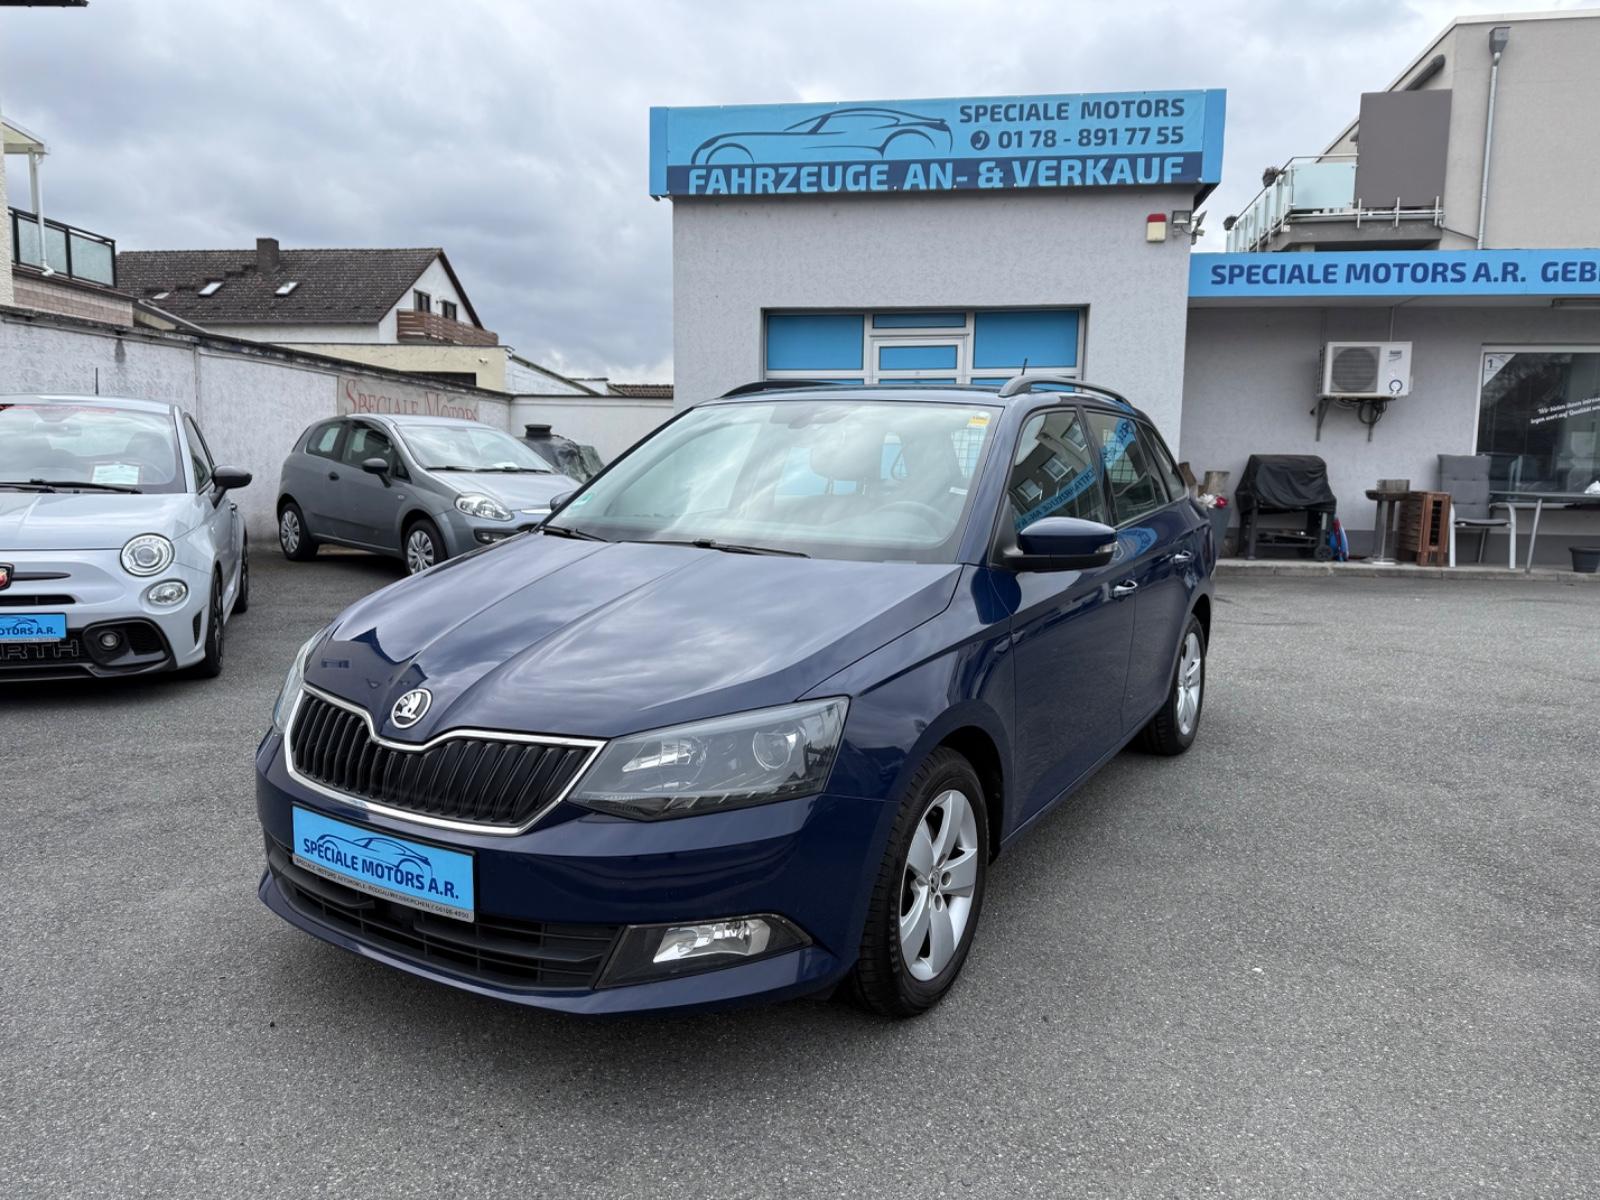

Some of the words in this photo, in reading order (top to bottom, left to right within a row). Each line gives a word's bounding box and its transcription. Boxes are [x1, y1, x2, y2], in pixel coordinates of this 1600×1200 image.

[960, 102, 1069, 123] SPECIALE
[1081, 98, 1185, 120] MOTORS
[689, 164, 889, 195] FAHRZEUGE
[903, 162, 968, 190] AN-
[977, 160, 1003, 188] &
[1012, 156, 1184, 187] VERKAUF
[1211, 263, 1338, 285] SPECIALE
[1345, 261, 1467, 284] MOTORS
[1472, 261, 1526, 283] A.R.
[1541, 261, 1600, 282] GEB
[303, 838, 359, 871] SPECIALE
[361, 858, 425, 890] MOTORS
[428, 877, 459, 899] A.R.
